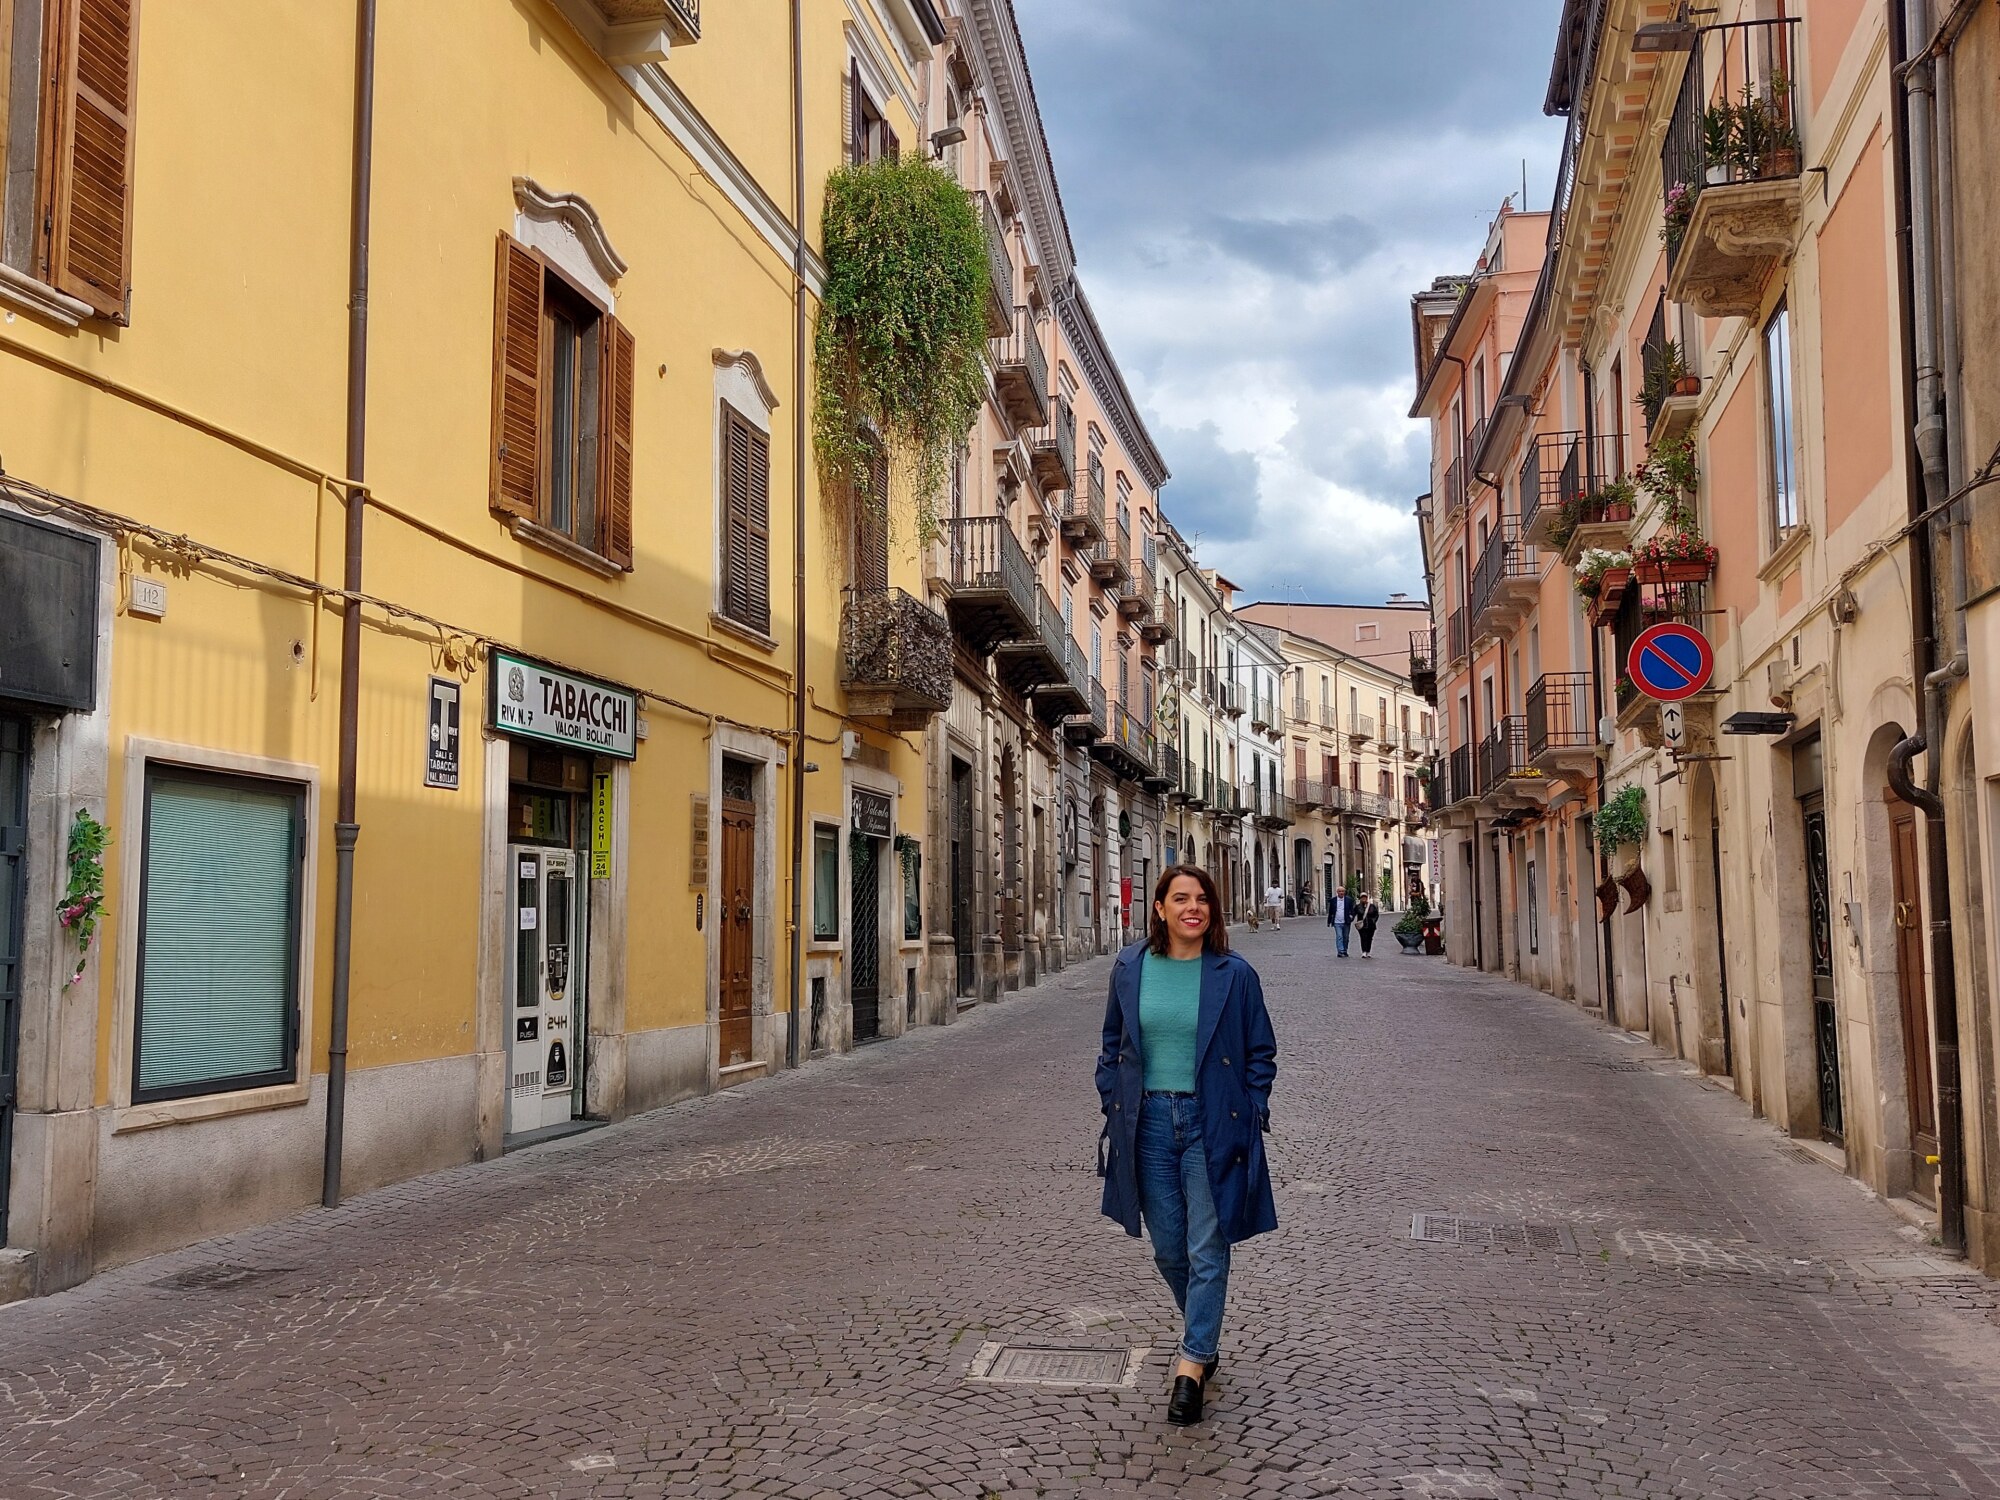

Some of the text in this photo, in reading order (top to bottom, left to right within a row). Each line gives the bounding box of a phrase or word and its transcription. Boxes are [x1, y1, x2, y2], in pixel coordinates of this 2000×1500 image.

[142, 587, 159, 605] 112
[501, 704, 533, 726] RIV. N. 7
[539, 676, 627, 734] TABACCHI
[433, 684, 457, 750] T
[555, 720, 614, 747] VALORI BOLLATI
[435, 750, 453, 760] SALI E
[429, 759, 457, 772] TABACCHI
[596, 774, 609, 848] TABACCHI
[547, 1016, 568, 1030] 24H
[519, 1031, 535, 1039] PUSH
